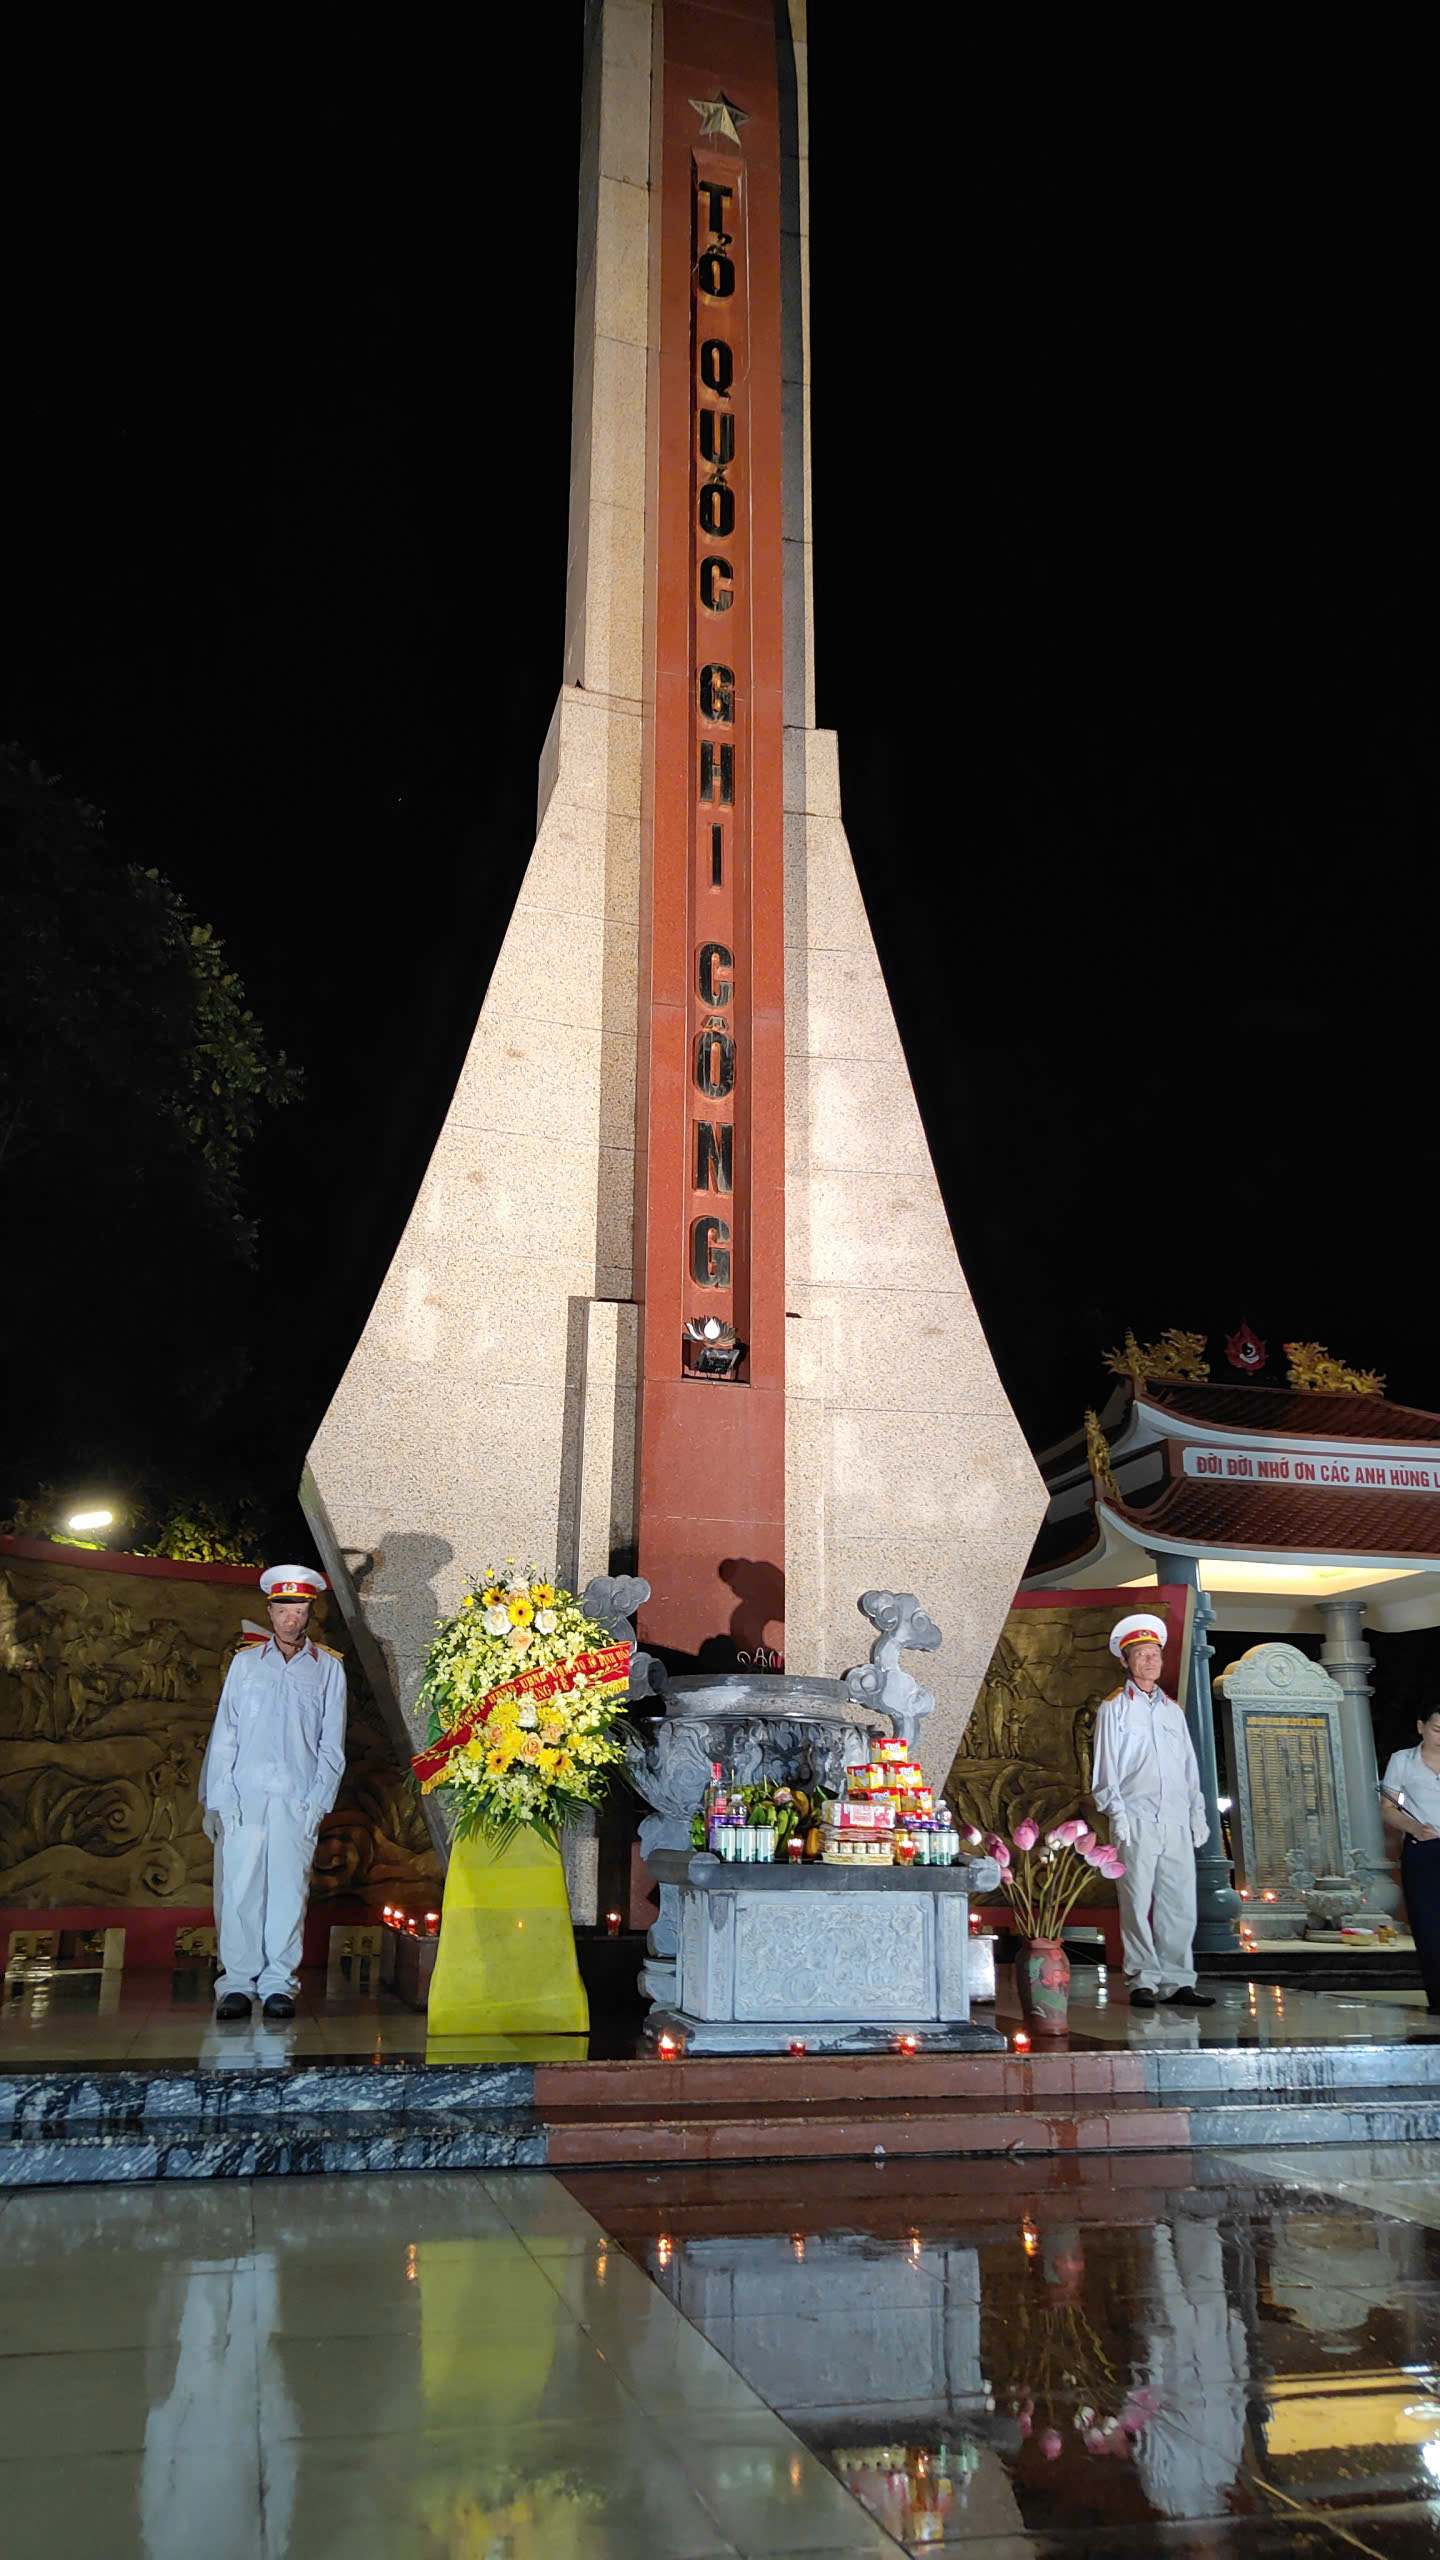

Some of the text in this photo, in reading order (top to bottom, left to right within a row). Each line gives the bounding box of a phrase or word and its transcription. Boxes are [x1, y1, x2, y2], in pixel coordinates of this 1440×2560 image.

[699, 337, 736, 612] QUỐC
[699, 662, 737, 889] GHI
[690, 941, 737, 1294] CÔNG
[1196, 1452, 1223, 1475] ĐỜI
[1226, 1454, 1254, 1477] ĐỜI
[1257, 1457, 1290, 1480] NHỚ
[1294, 1461, 1316, 1481] ƠN
[1320, 1460, 1350, 1483] CÁC
[1355, 1466, 1387, 1485] ANH
[1390, 1464, 1431, 1488] HÙNG
